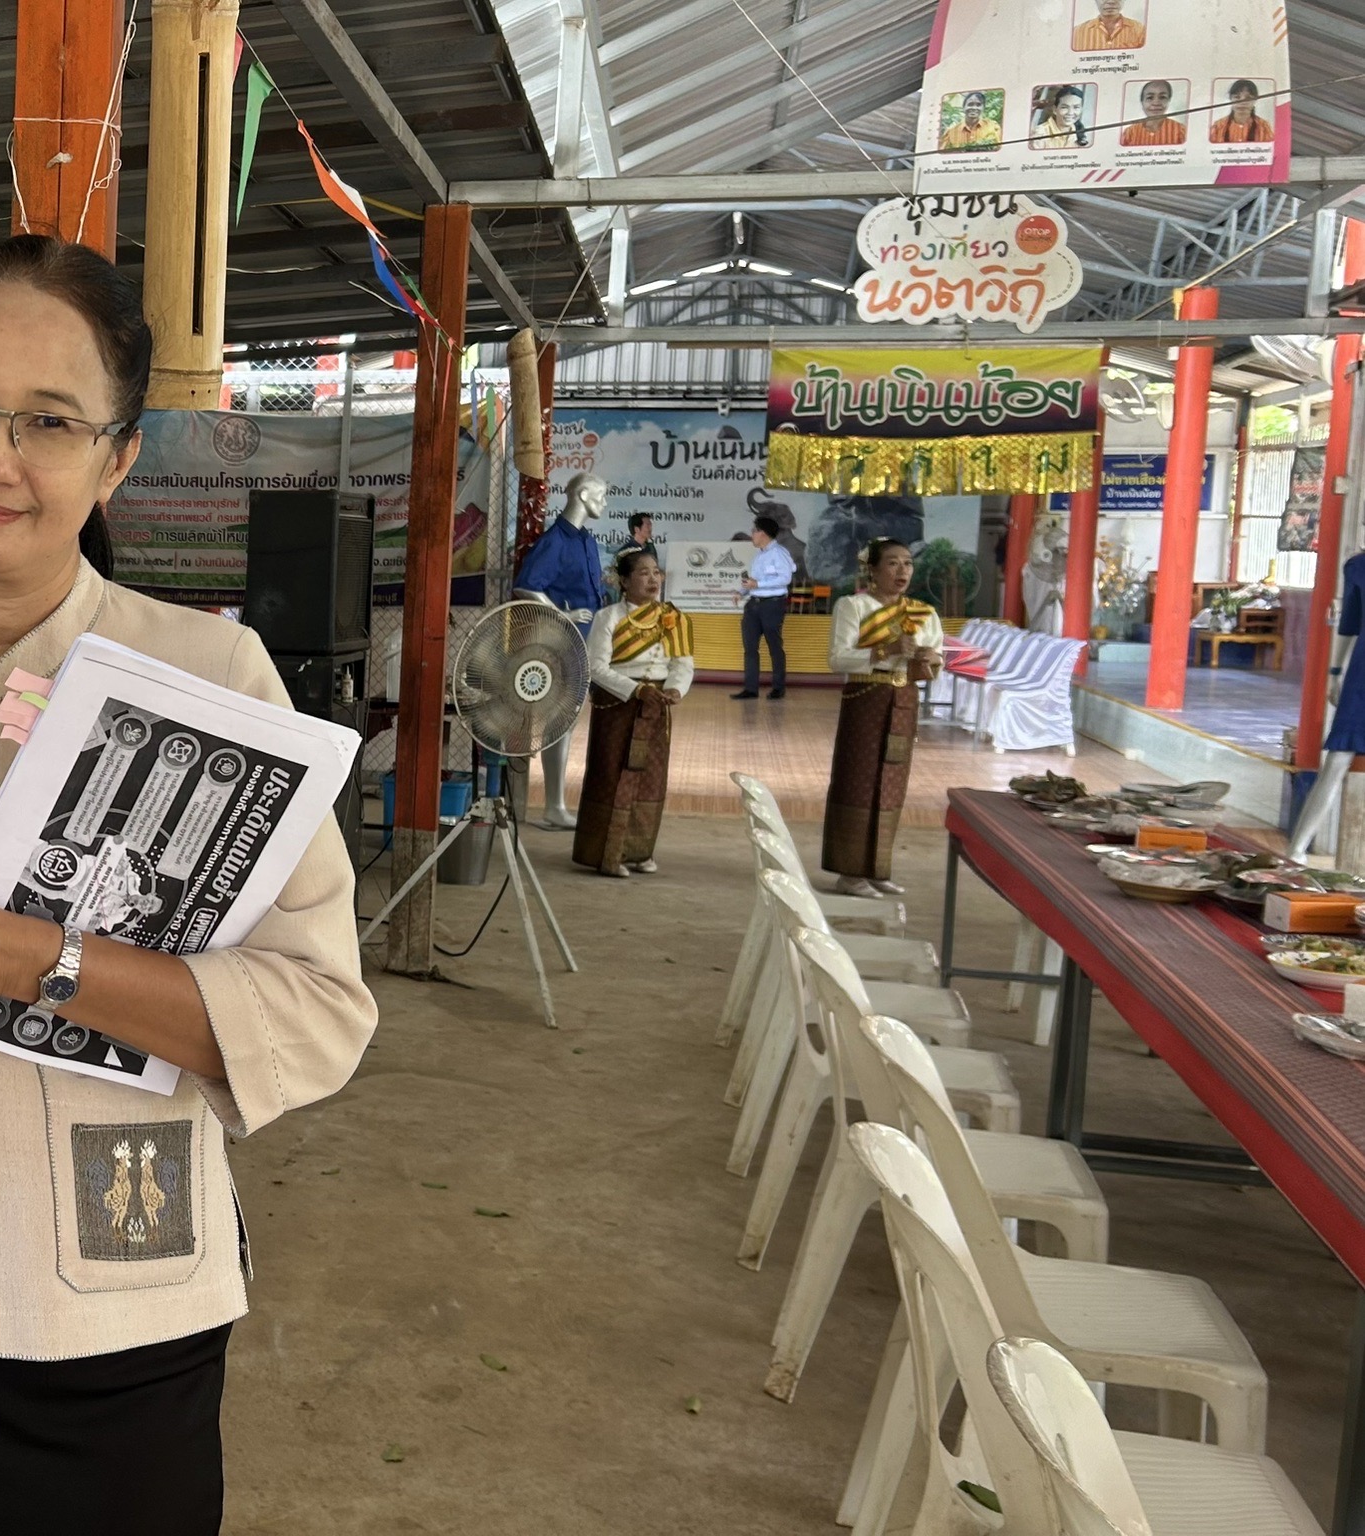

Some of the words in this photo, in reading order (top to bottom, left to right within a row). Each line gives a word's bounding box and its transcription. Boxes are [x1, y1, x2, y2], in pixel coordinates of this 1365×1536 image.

[903, 194, 1019, 236] ชุมชน
[880, 223, 1009, 263] ท่องเที่ยว
[863, 262, 1047, 325] นวัตวิถี
[791, 361, 1086, 430] บ้านเนินน้อย
[687, 570, 713, 579] Home
[204, 766, 292, 904] ประเด็นเน้นย้ำ
[181, 912, 213, 953] APPROVE
